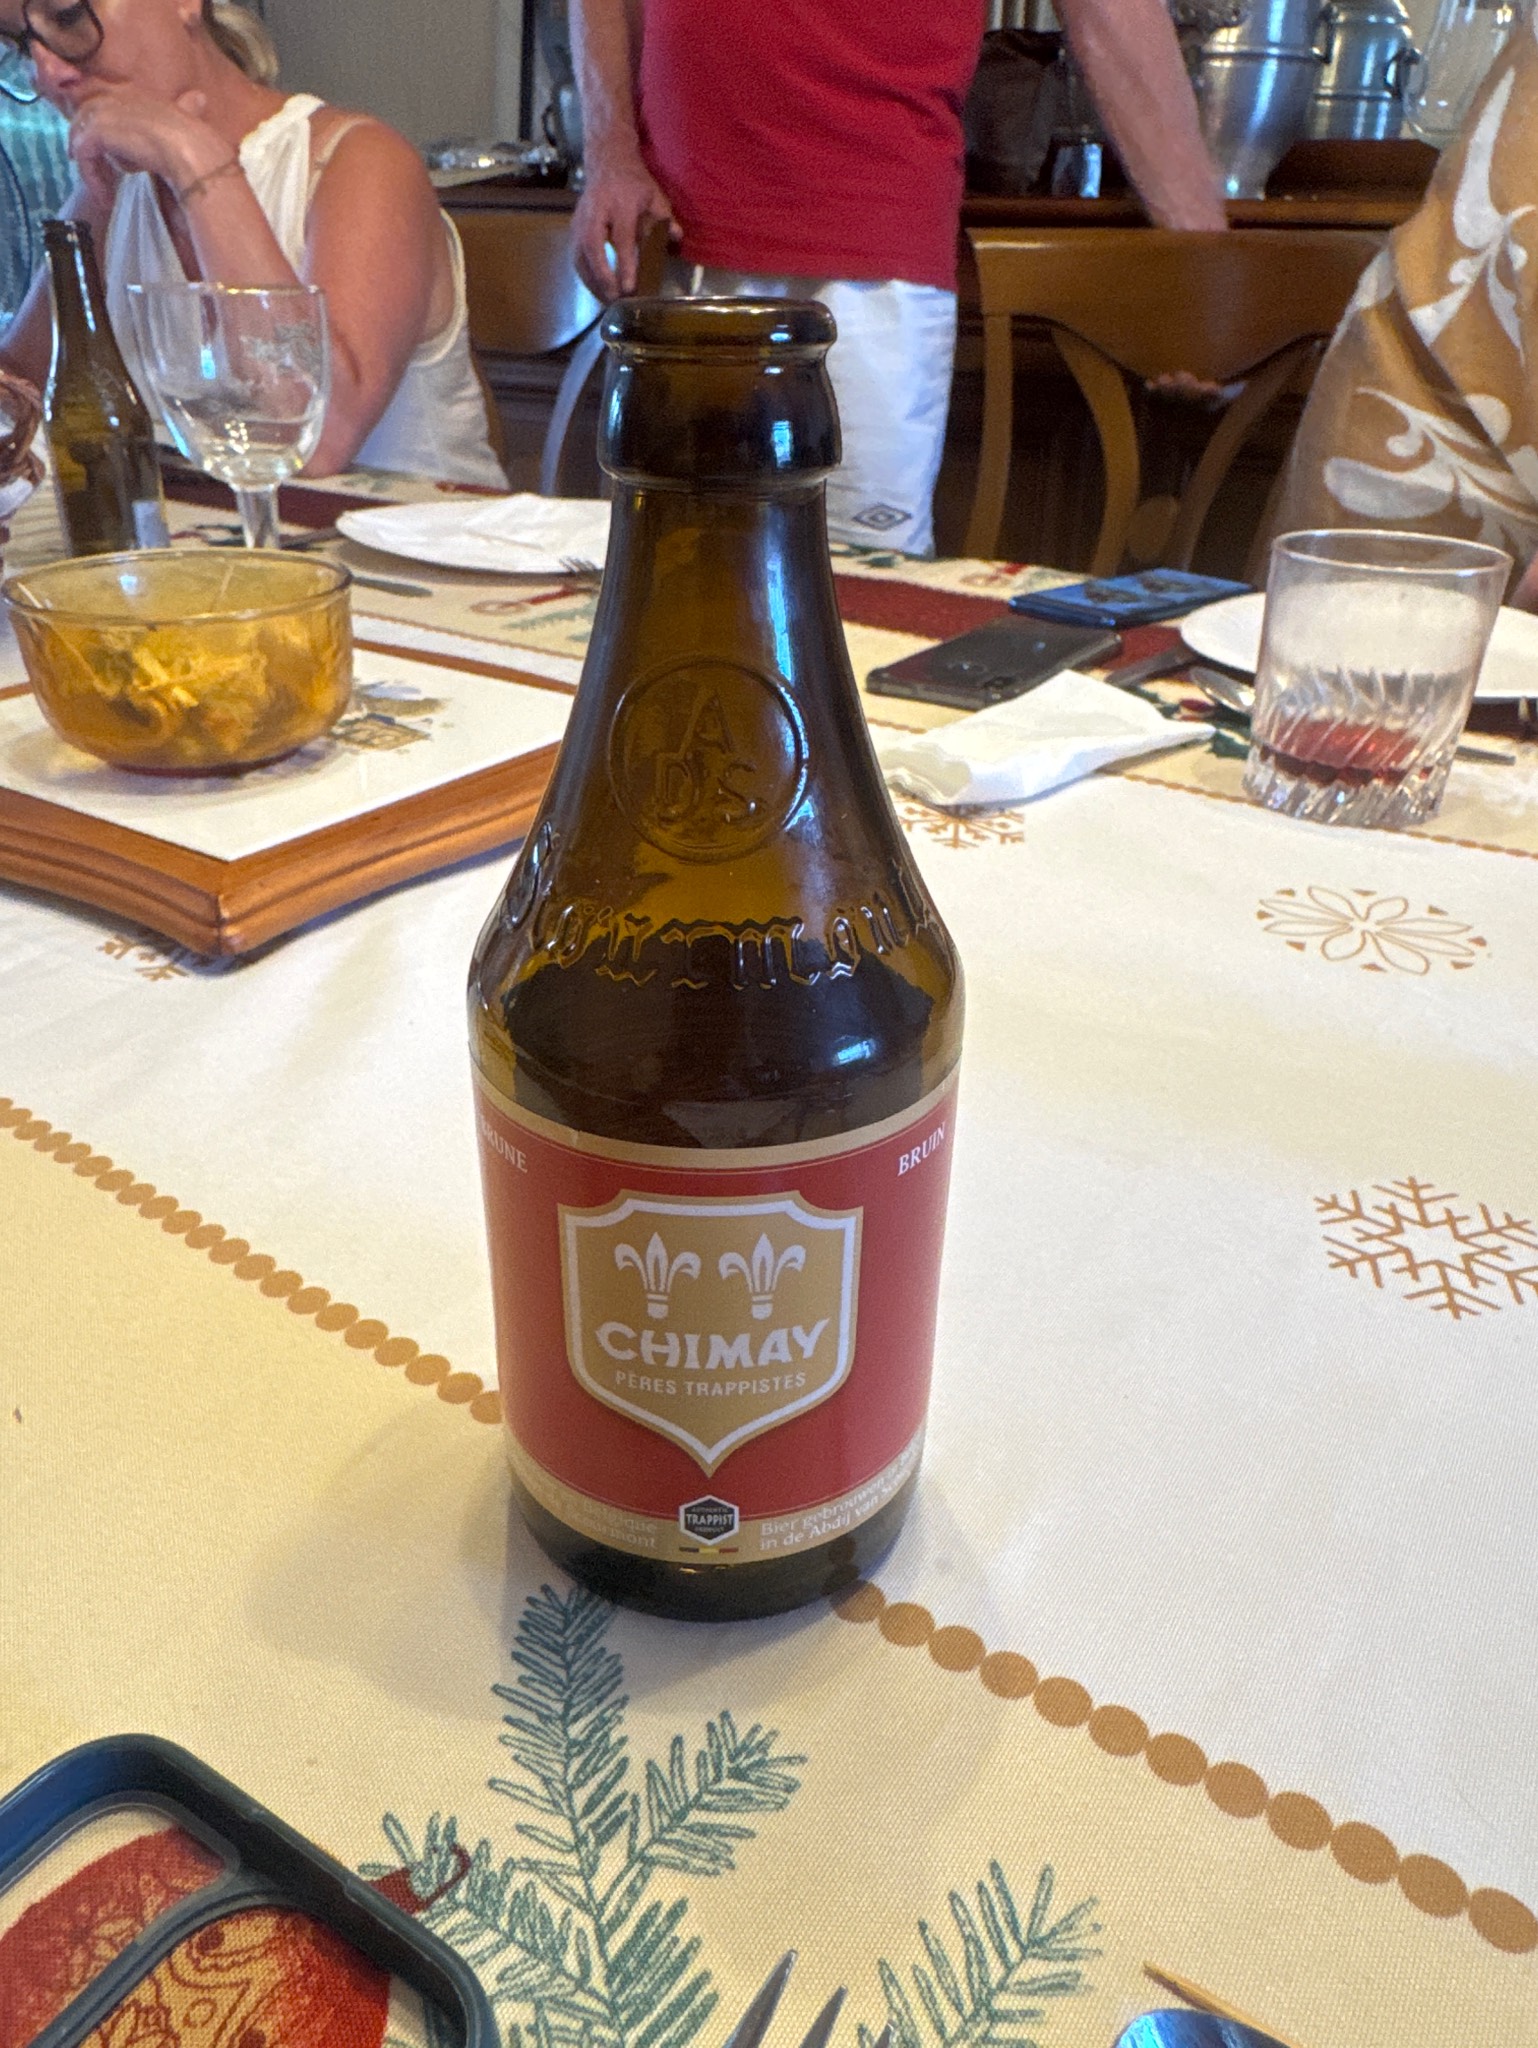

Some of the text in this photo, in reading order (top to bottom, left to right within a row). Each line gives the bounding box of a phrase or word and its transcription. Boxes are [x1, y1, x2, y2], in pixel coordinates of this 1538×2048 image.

[897, 1121, 945, 1176] BRUIN
[595, 1318, 830, 1369] CHIMAY
[685, 1372, 806, 1397] TRAPPISTES
[686, 1513, 734, 1526] TRAPPIST
[760, 1495, 879, 1551] in de Abdij van
[761, 1519, 798, 1536] Bier
[803, 1476, 885, 1530] gebrouwen
